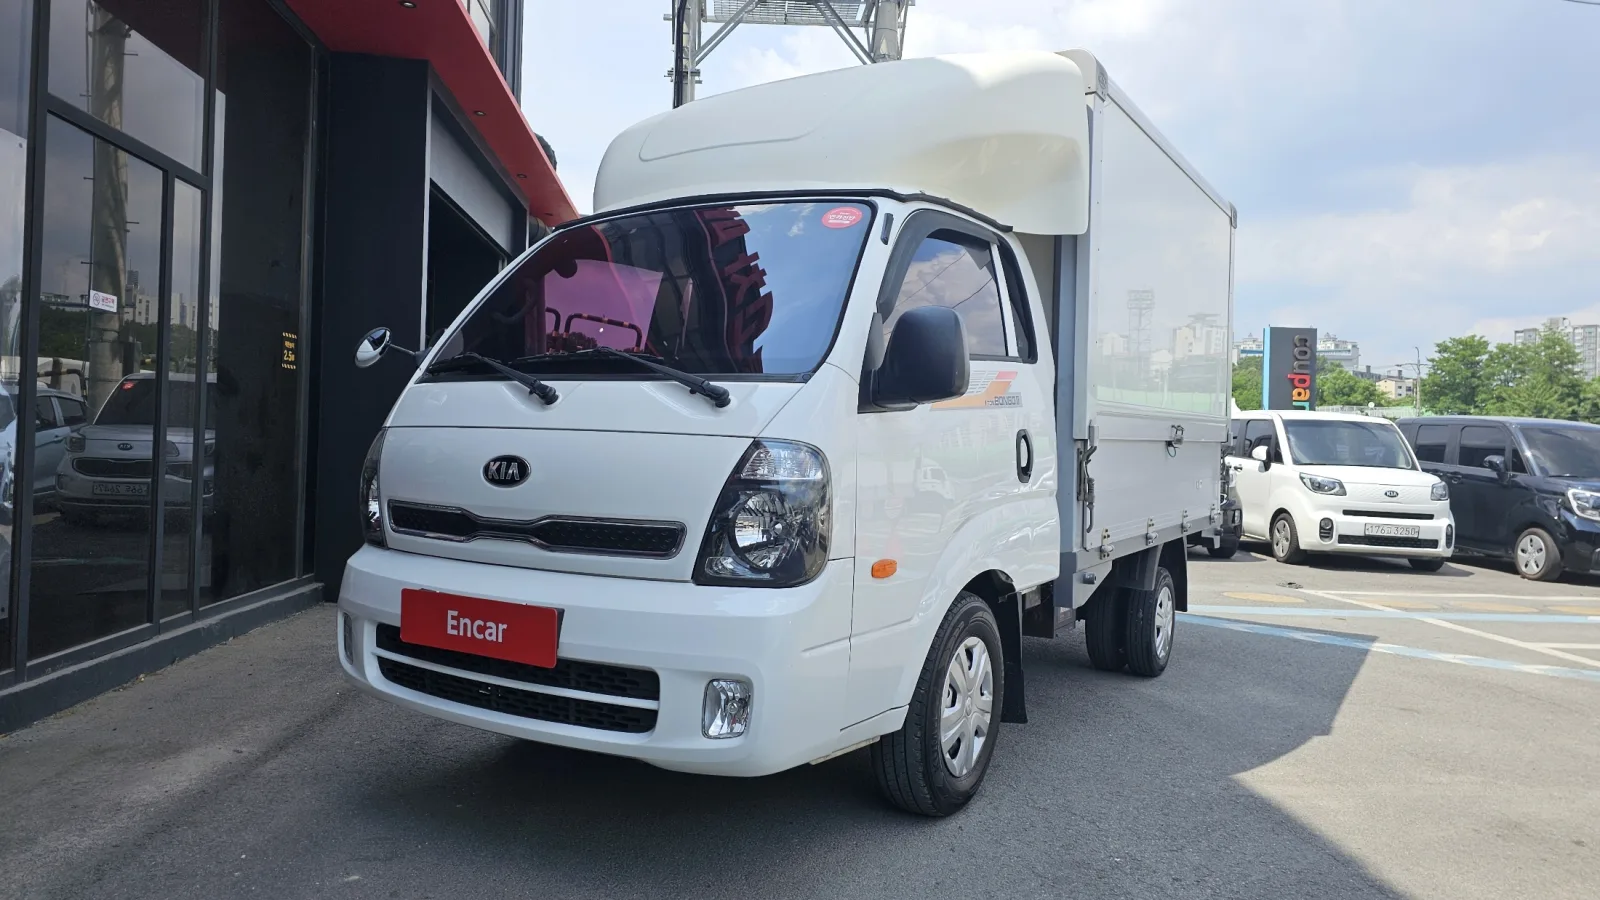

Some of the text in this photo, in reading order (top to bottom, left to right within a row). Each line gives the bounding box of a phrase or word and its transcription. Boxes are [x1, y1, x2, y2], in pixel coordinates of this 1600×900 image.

[487, 461, 520, 480] KIA
[1393, 526, 1416, 536] 3250
[446, 609, 508, 642] Encar
